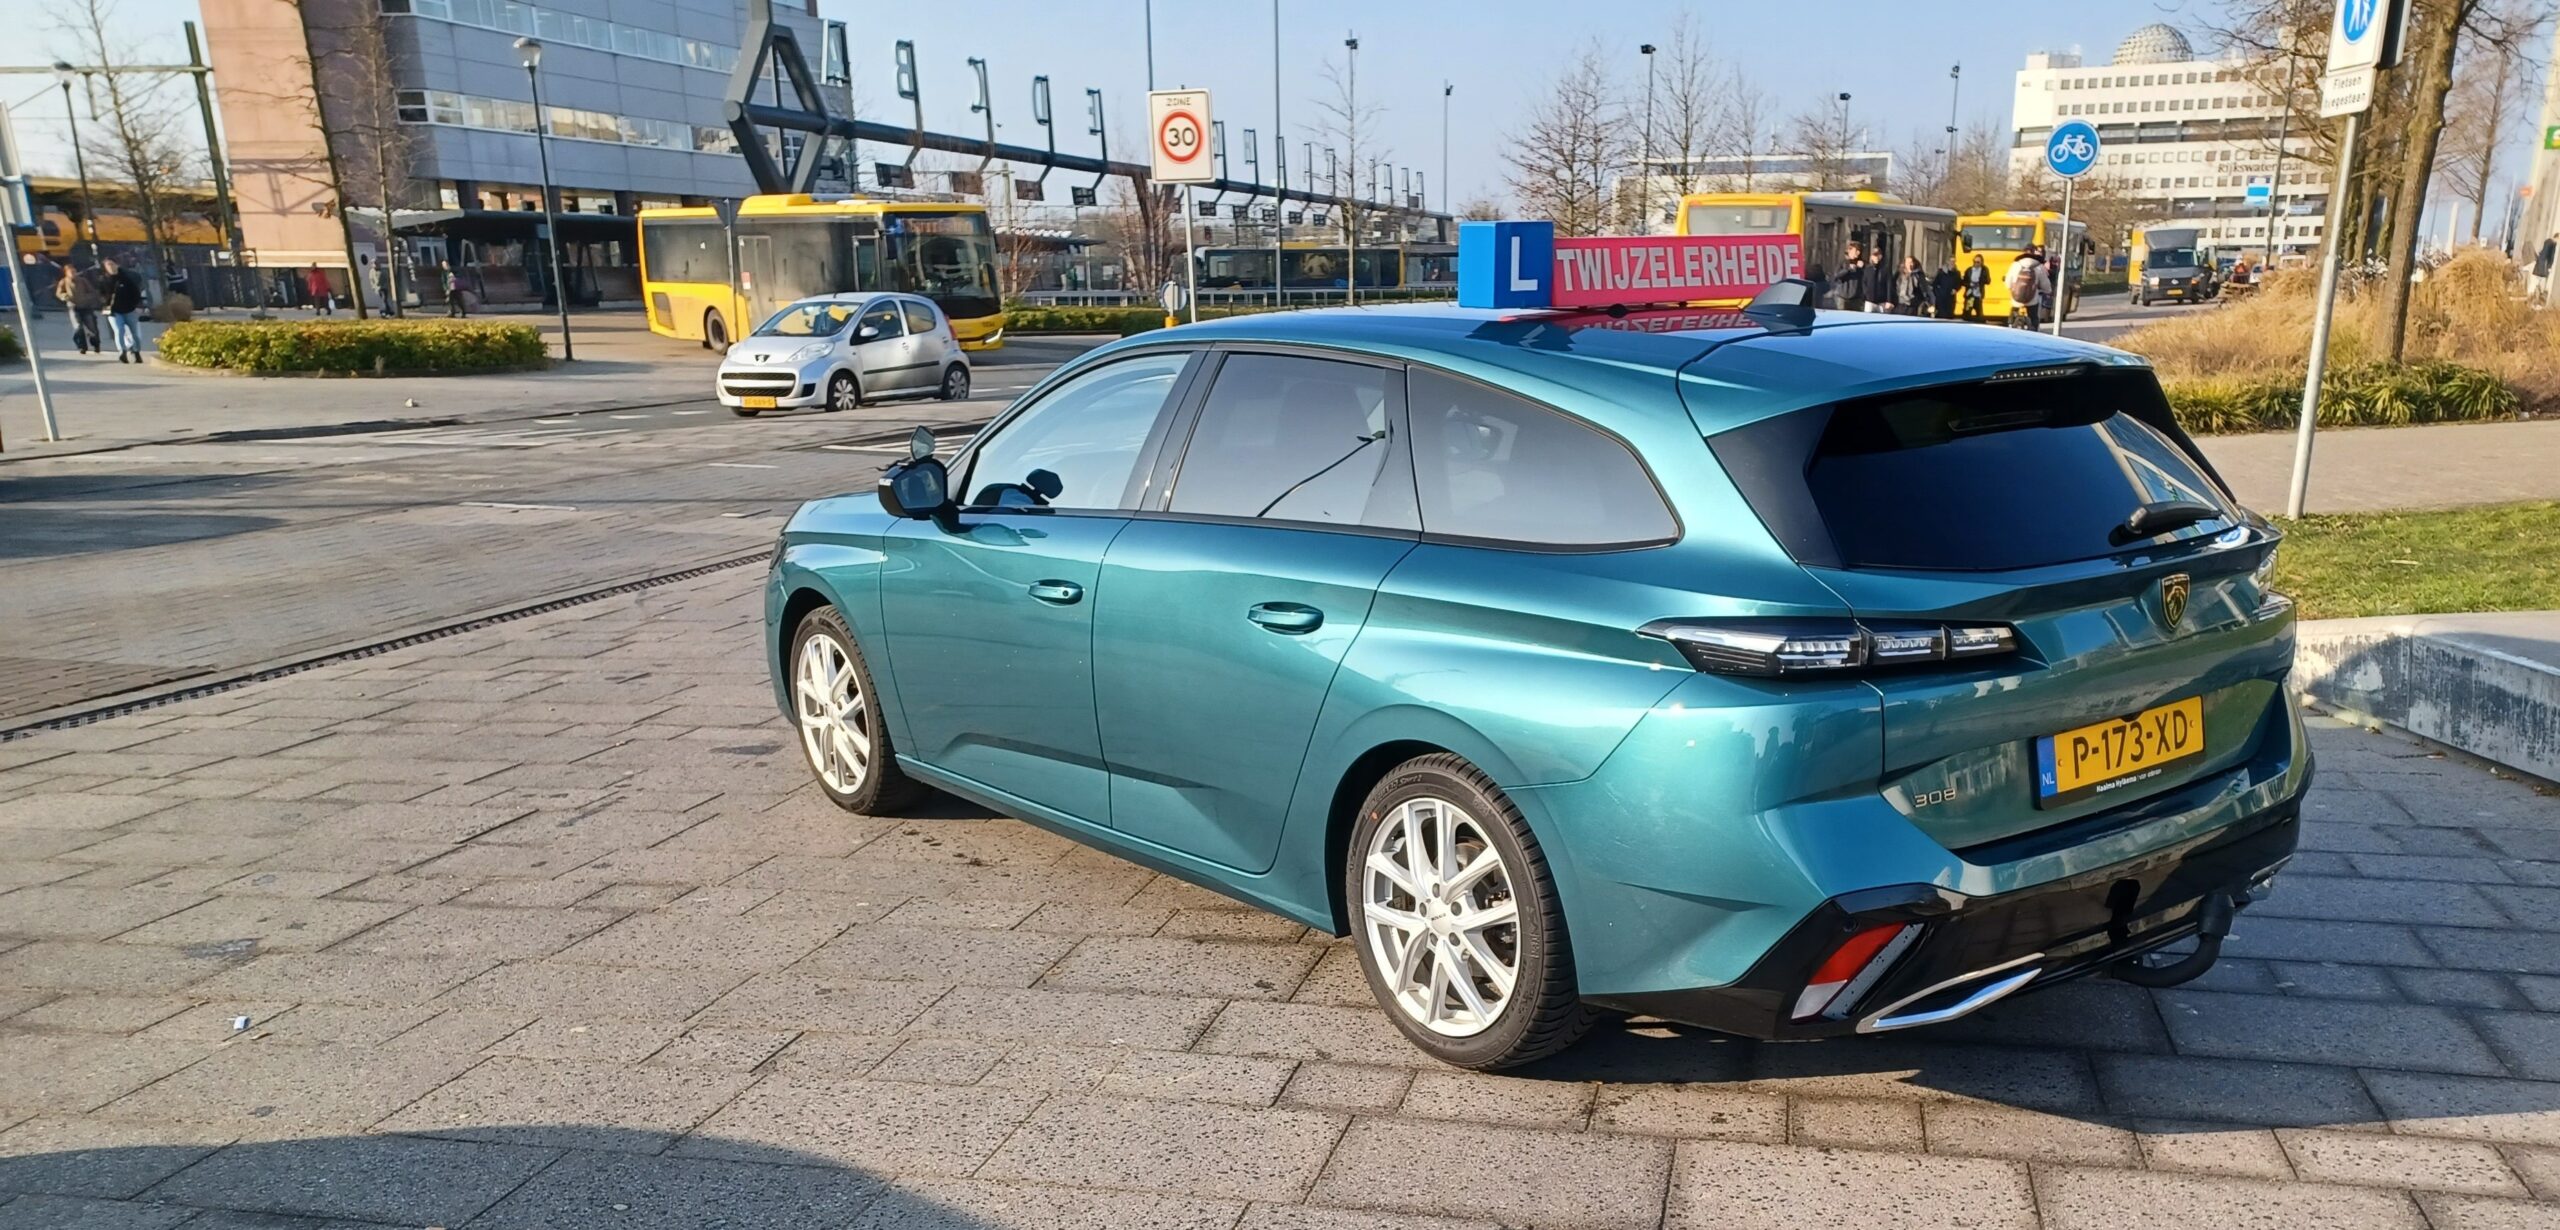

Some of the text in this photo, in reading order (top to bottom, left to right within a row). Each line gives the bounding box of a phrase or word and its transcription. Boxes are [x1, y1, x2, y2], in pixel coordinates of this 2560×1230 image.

[1166, 97, 1192, 107] ZONE
[1168, 127, 1196, 147] 30
[1510, 235, 1538, 292] L
[1556, 244, 1800, 292] TWIJZELERHEIDE
[2073, 709, 2188, 780] P-173-XD
[2042, 772, 2055, 785] NL
[1914, 787, 1956, 808] 308
